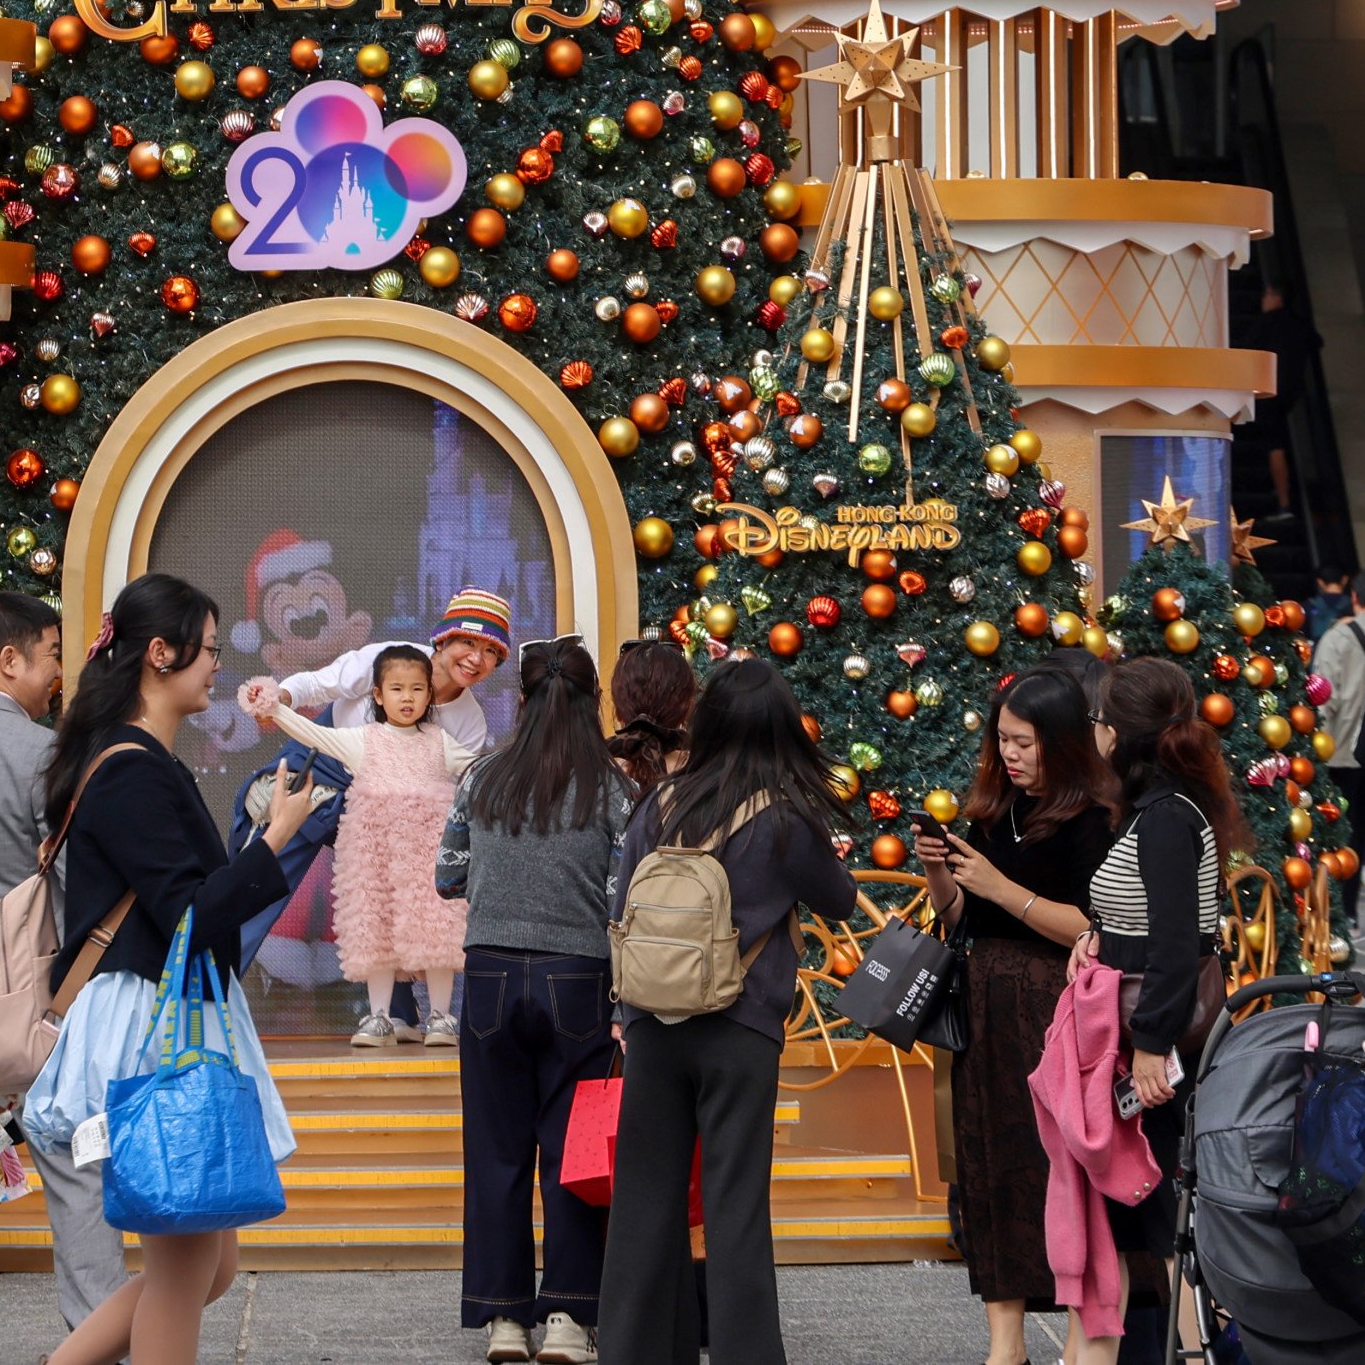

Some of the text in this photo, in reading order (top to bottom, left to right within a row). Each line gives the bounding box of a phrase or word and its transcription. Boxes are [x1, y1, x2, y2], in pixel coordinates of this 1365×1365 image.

[837, 504, 958, 523] HONG KONG
[896, 968, 930, 1017] FOLLOW US!
